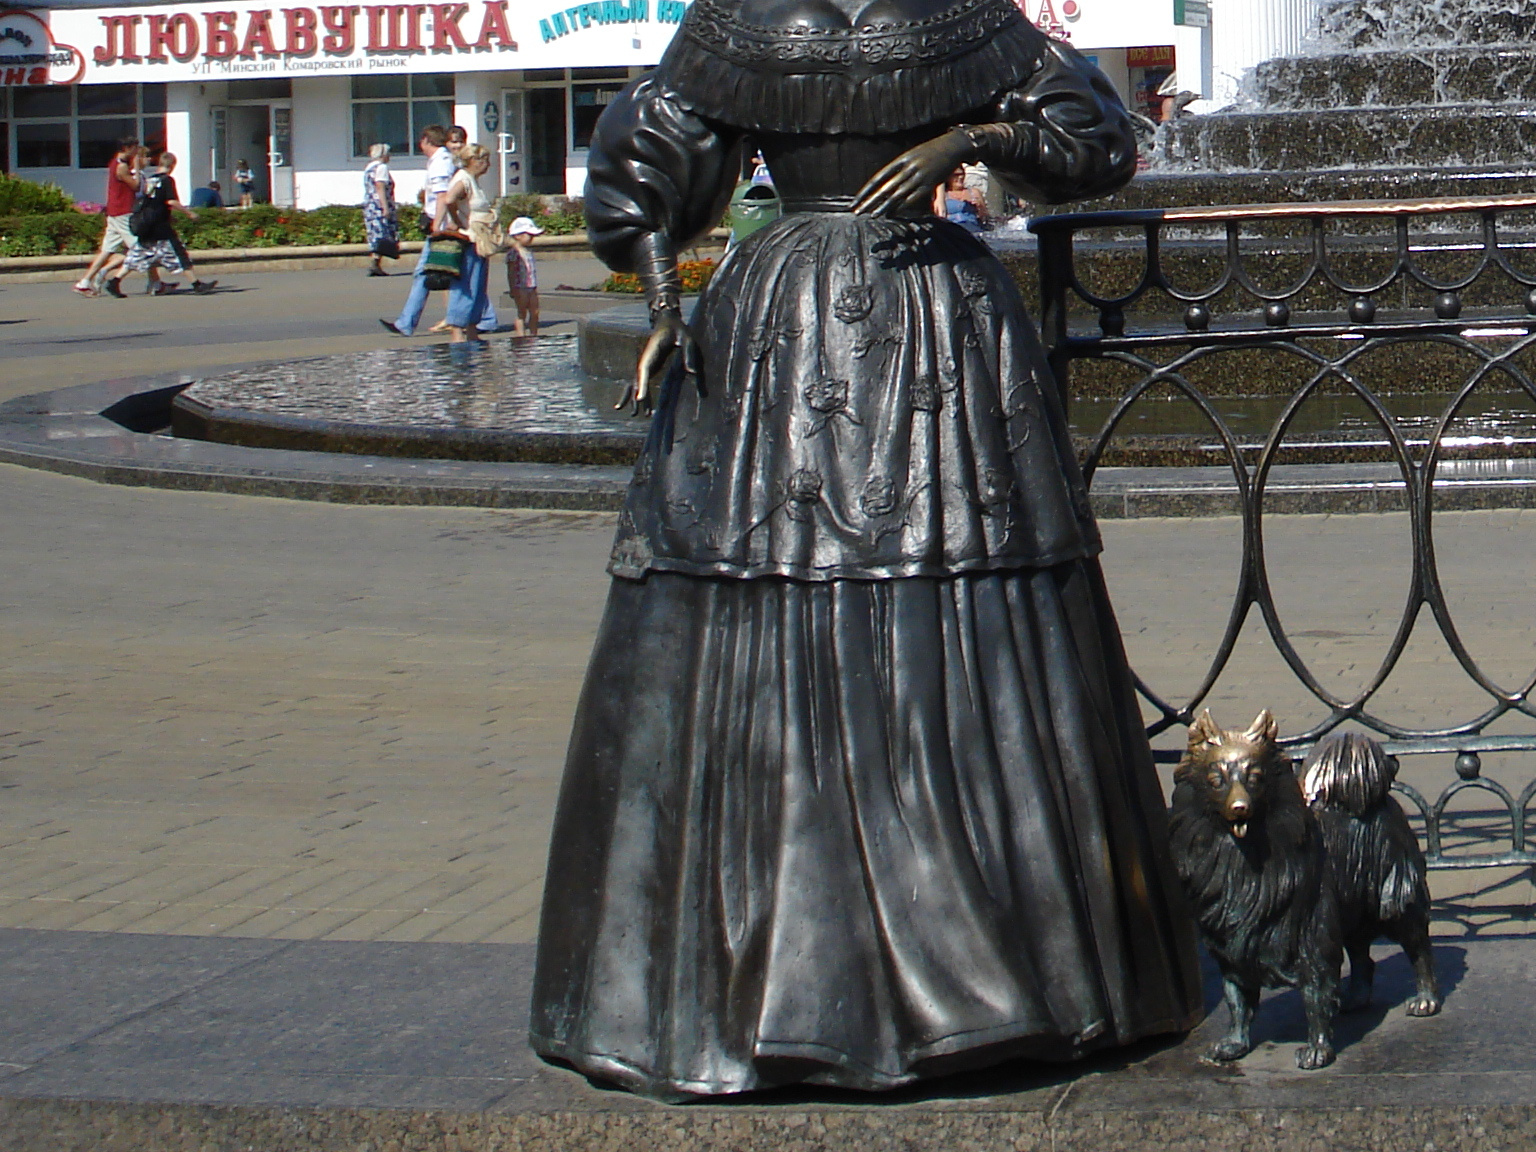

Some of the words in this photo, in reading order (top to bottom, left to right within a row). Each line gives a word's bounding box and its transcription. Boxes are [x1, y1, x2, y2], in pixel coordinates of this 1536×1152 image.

[657, 0, 687, 25] КИ
[94, 0, 517, 65] ЛЮБАВУШКА
[192, 62, 211, 74] УП
[283, 57, 363, 72] Комаровский
